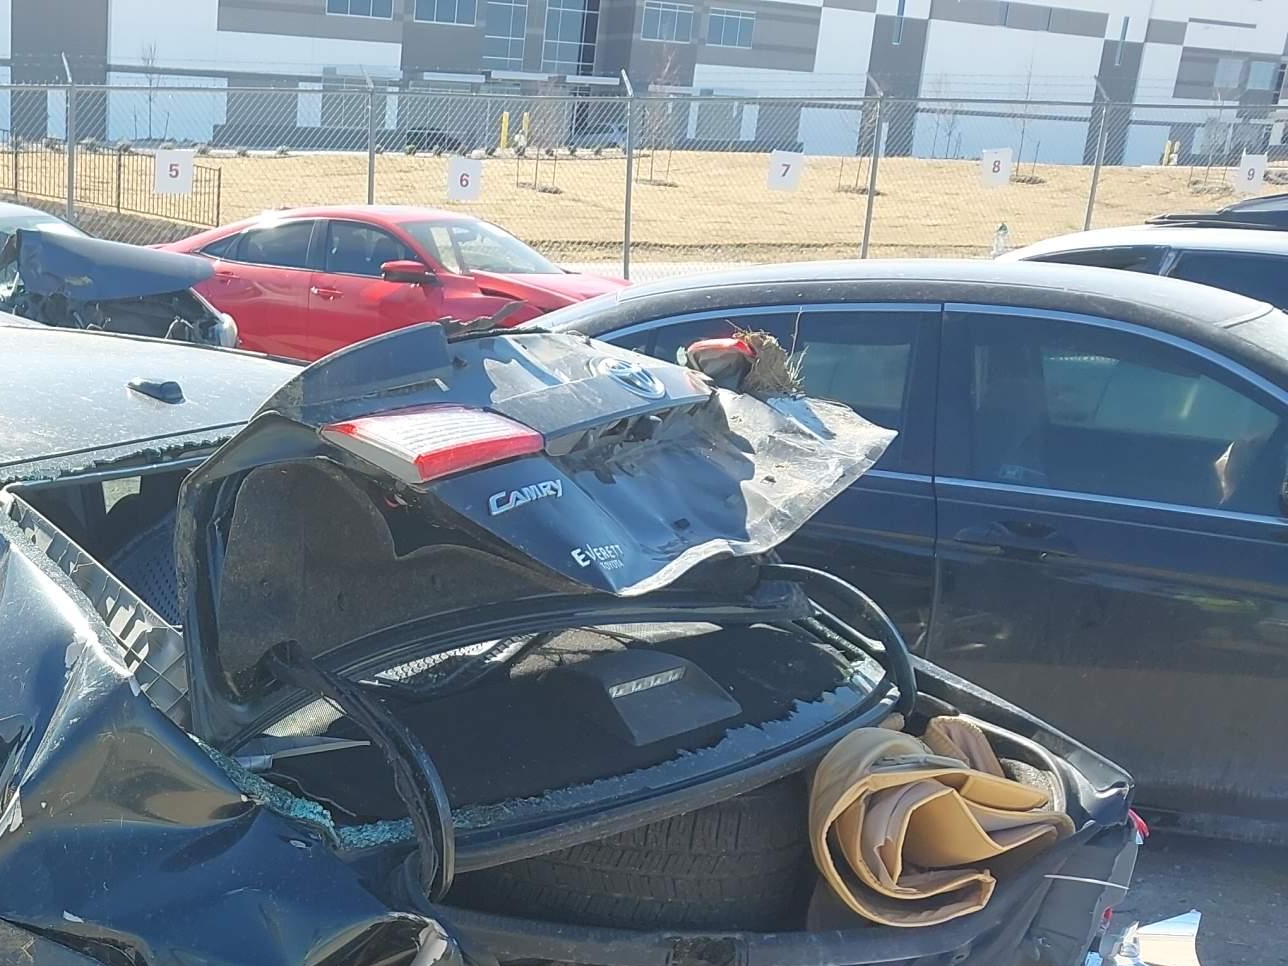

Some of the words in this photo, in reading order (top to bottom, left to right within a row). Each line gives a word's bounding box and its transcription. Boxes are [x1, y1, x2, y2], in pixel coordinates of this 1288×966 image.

[169, 163, 180, 178] 5
[781, 163, 791, 177] 7
[992, 160, 1001, 173] 8
[1247, 167, 1256, 181] 9
[459, 173, 470, 188] 6
[489, 479, 562, 516] CAMRY
[570, 543, 624, 568] EVERETT
